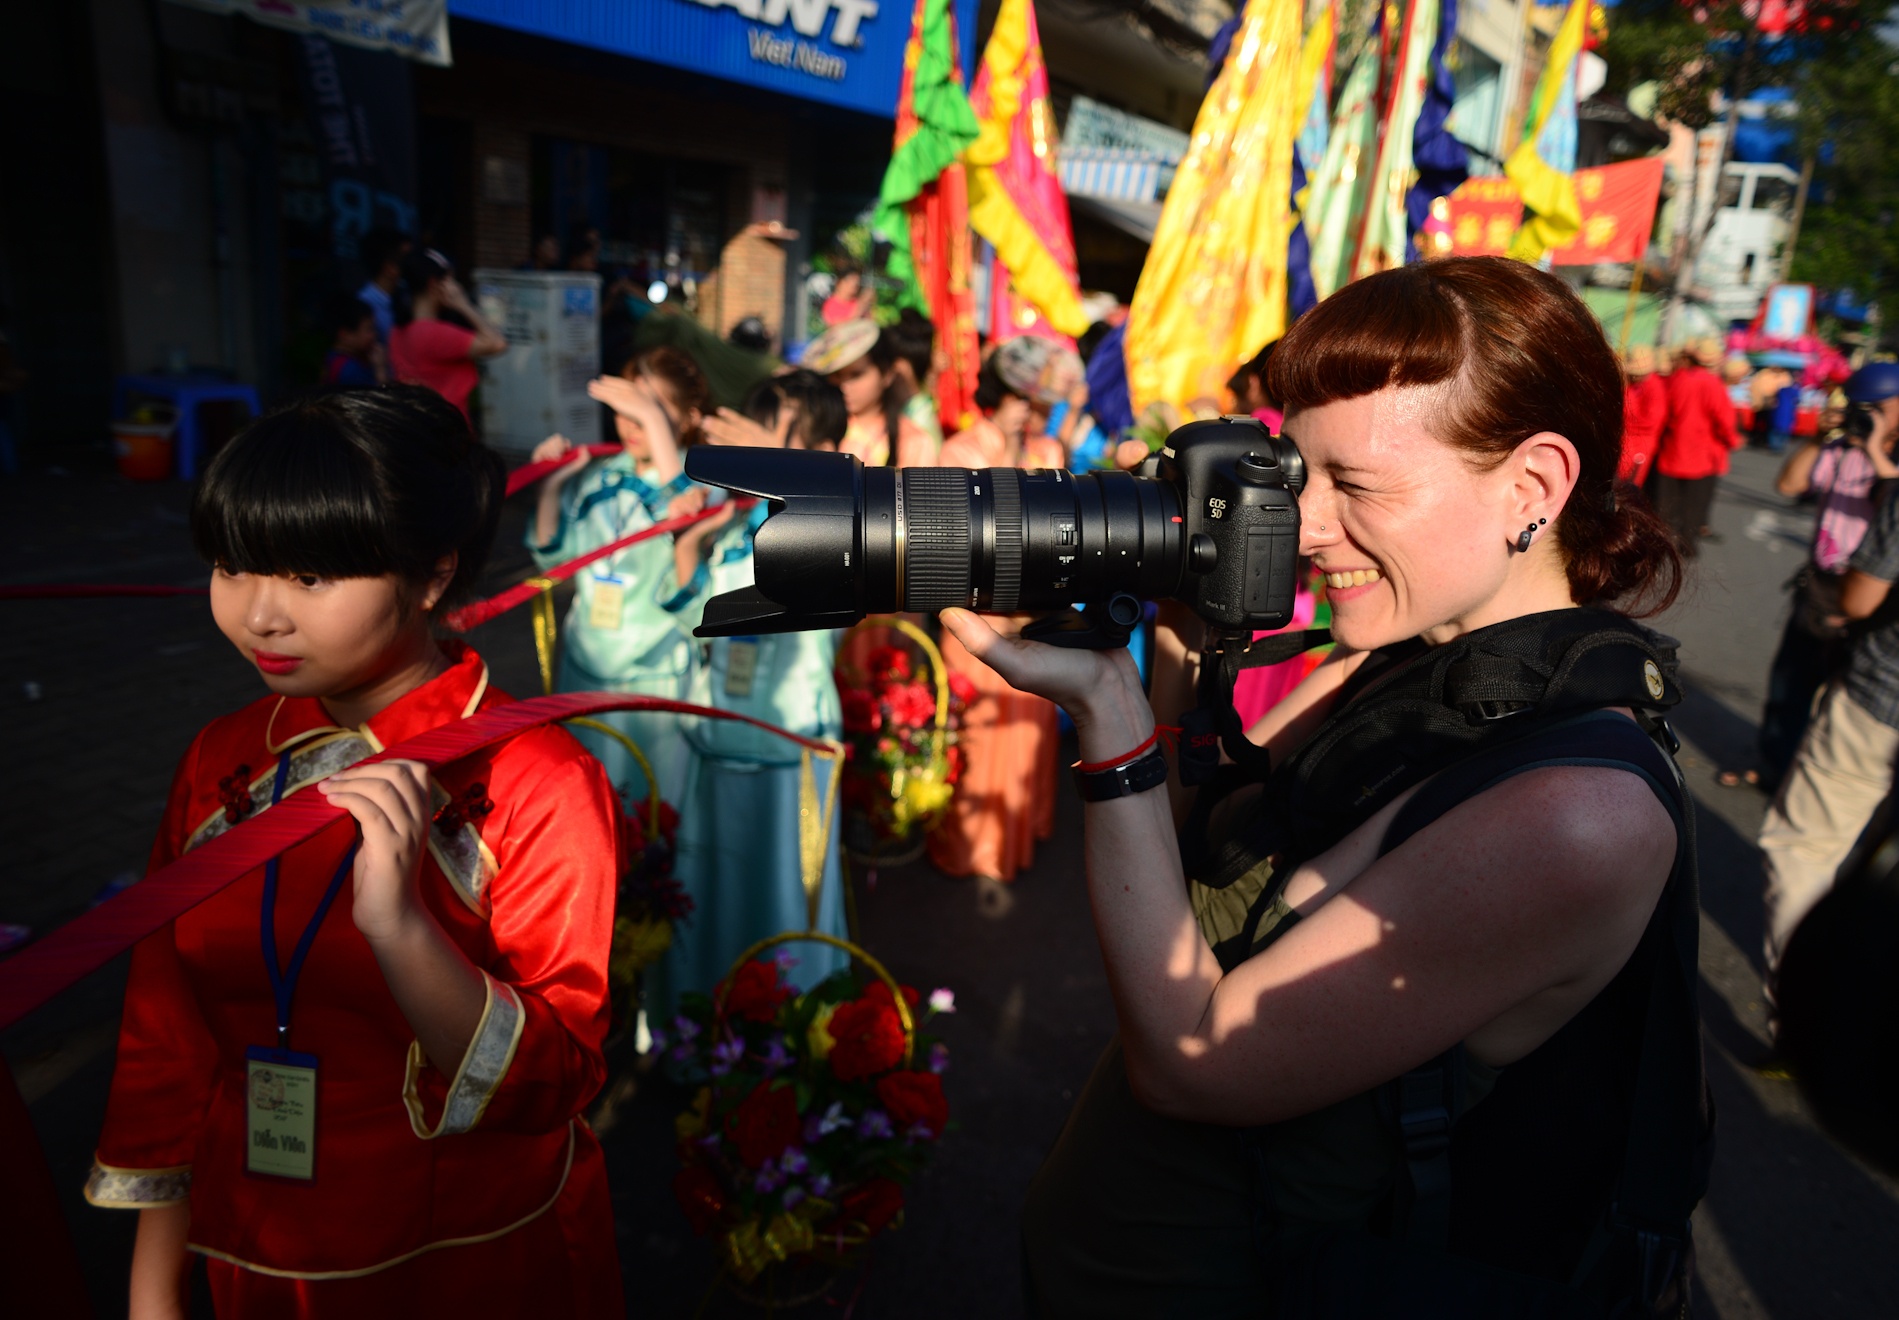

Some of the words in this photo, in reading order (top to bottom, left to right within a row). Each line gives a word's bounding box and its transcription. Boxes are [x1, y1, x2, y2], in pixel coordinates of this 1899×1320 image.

[748, 27, 793, 68] Viet
[792, 41, 847, 80] Nam
[1209, 497, 1227, 510] EOS
[1210, 508, 1223, 519] 5D
[1190, 732, 1218, 748] SIG
